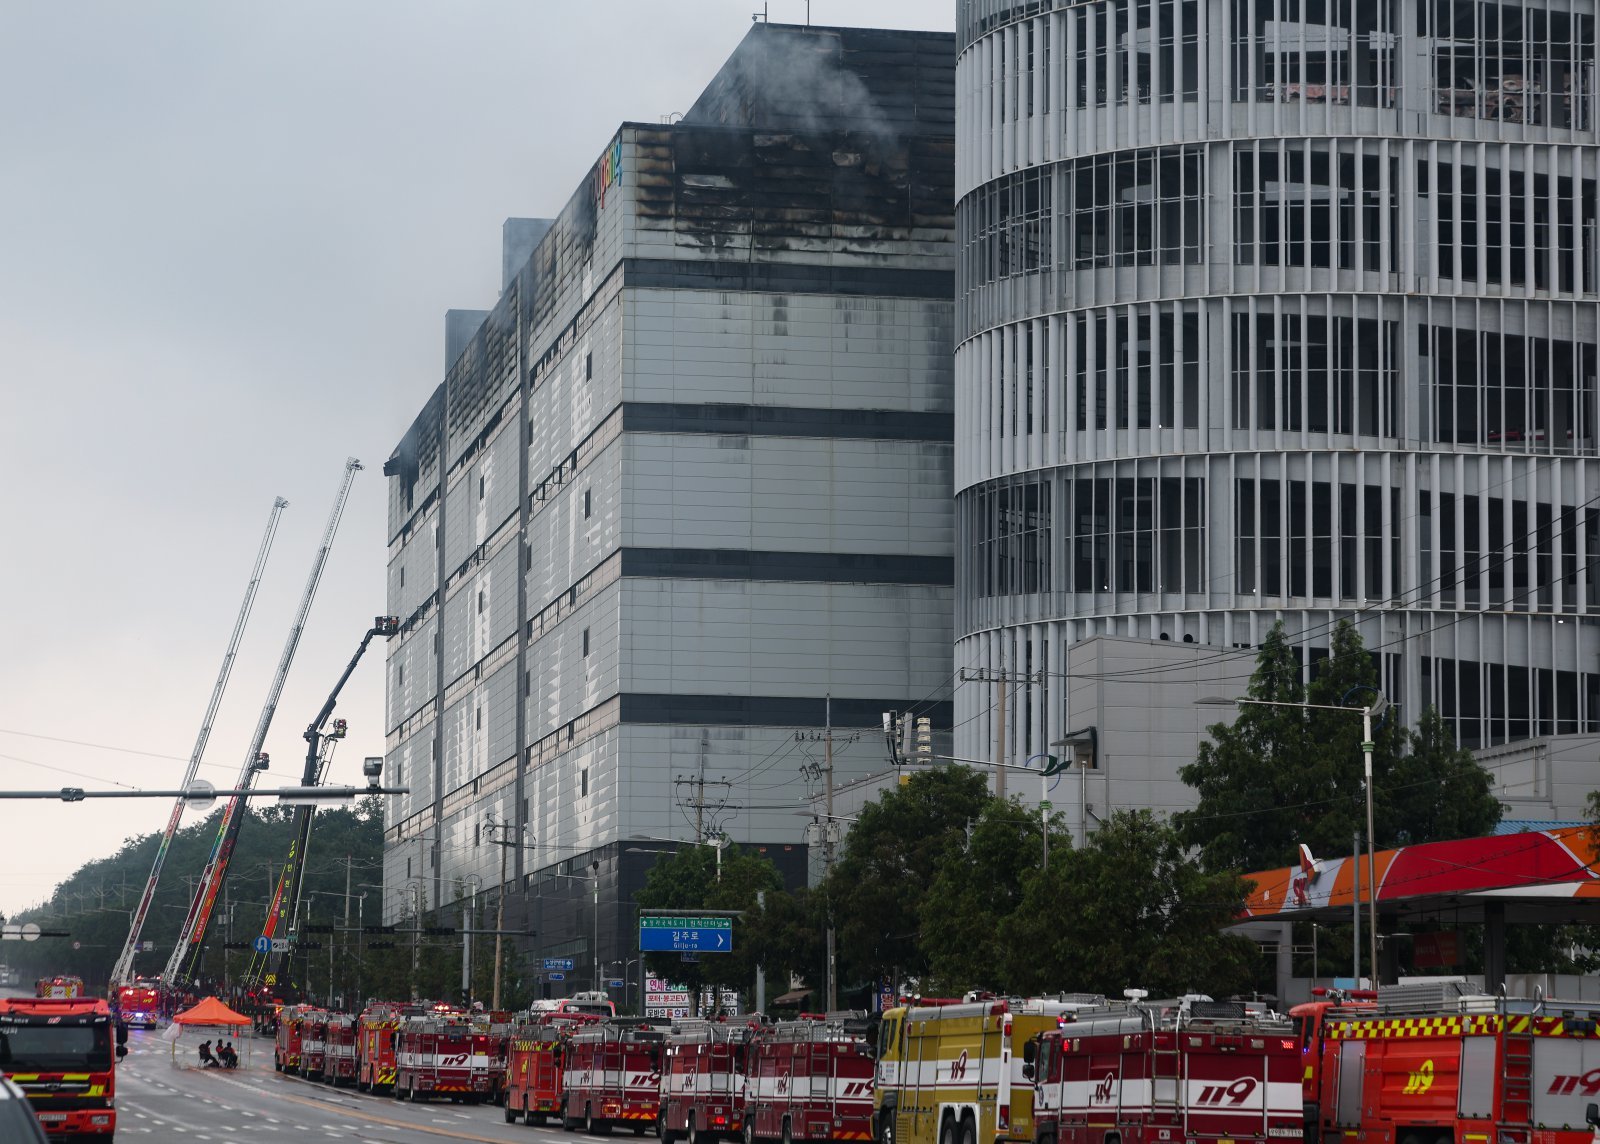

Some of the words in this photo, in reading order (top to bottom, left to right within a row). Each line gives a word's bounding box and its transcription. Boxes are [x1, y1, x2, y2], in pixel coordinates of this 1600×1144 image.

[672, 931, 699, 942] 길주로
[673, 942, 698, 950] Gilju-ro
[441, 1053, 469, 1066] 119
[950, 1048, 968, 1082] 119
[630, 1070, 660, 1086] 119
[1095, 1071, 1114, 1104] 119
[1402, 1058, 1435, 1095] 119
[1196, 1075, 1258, 1106] 119
